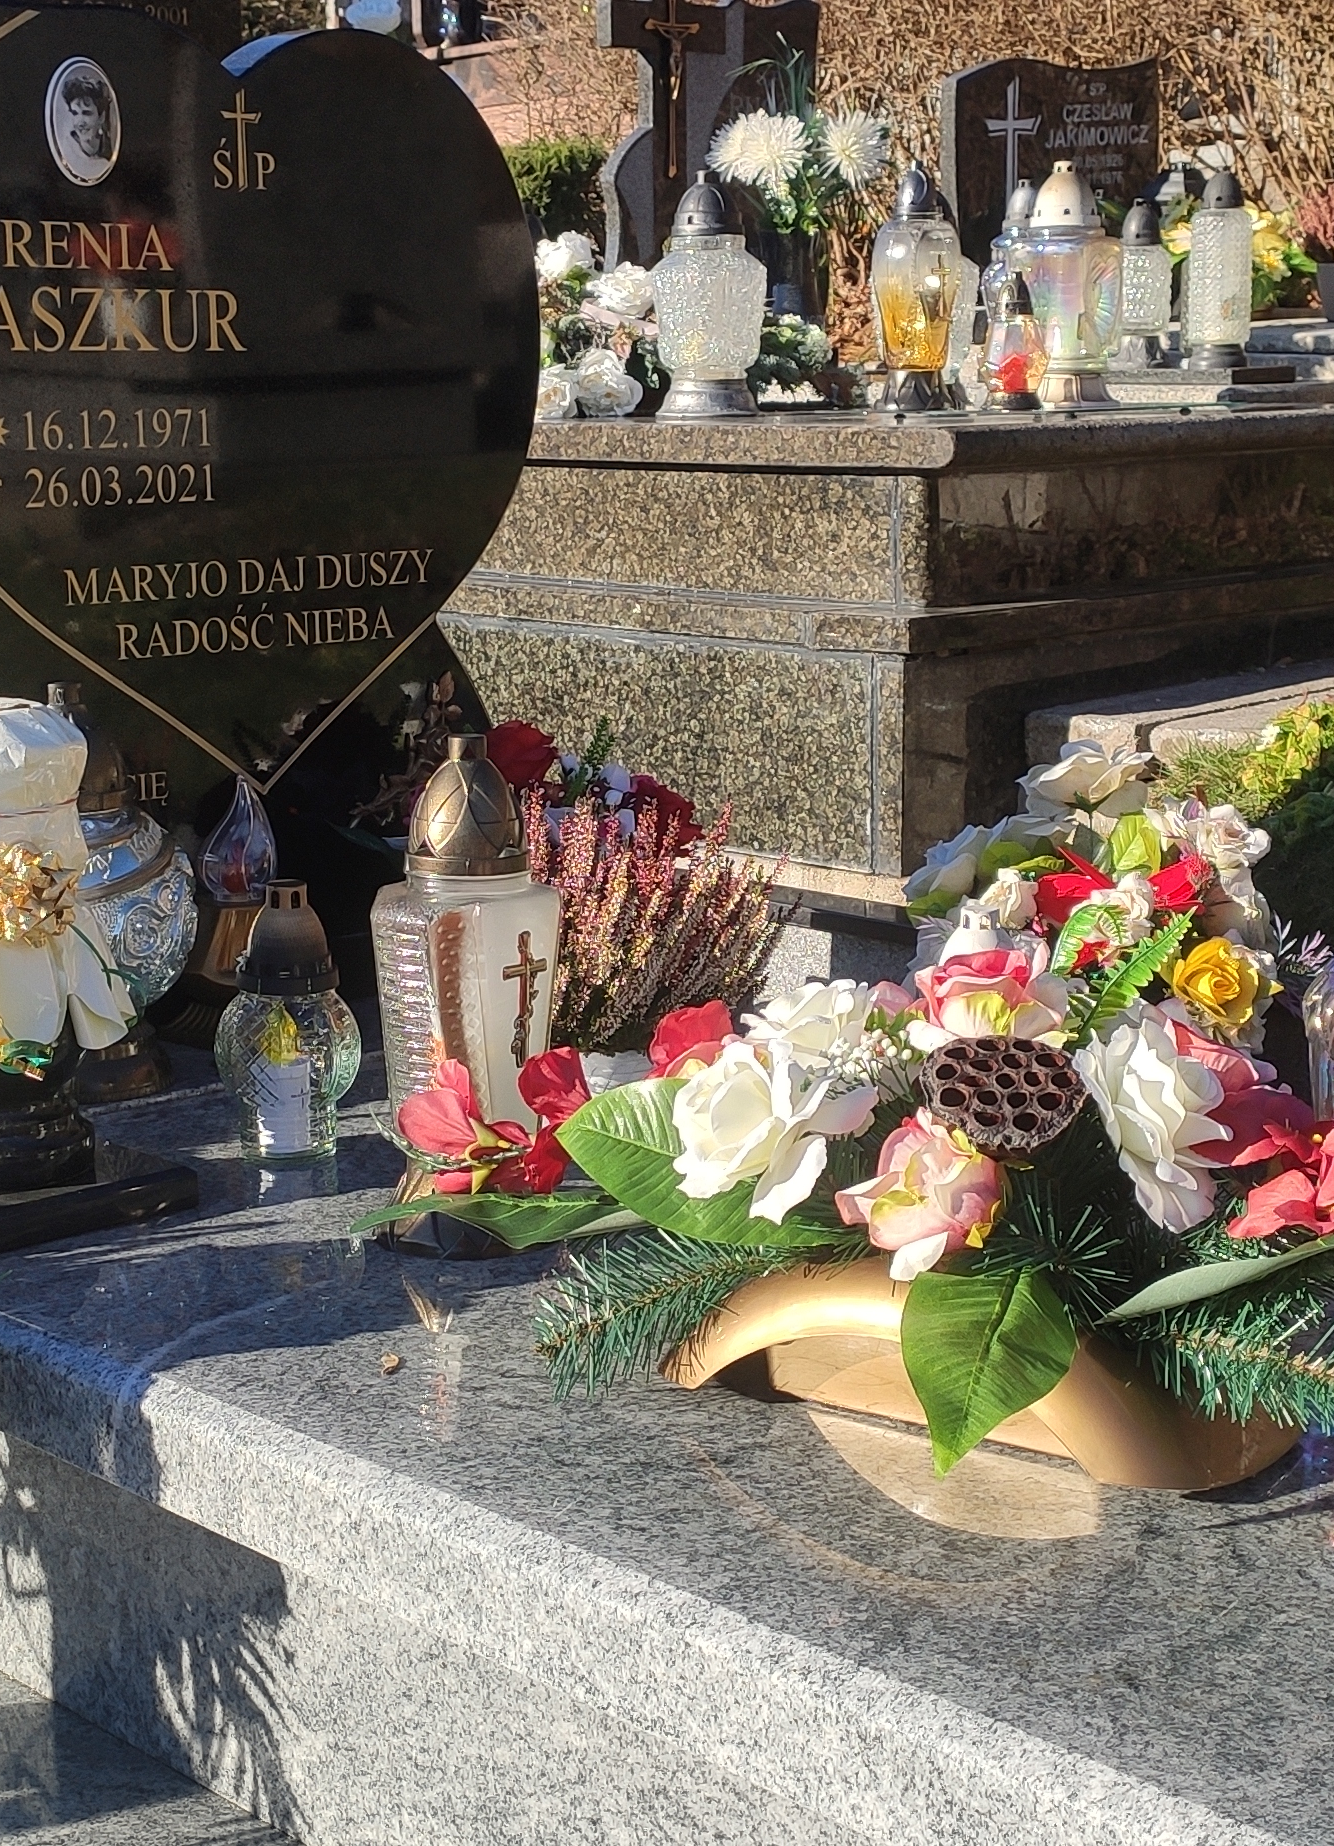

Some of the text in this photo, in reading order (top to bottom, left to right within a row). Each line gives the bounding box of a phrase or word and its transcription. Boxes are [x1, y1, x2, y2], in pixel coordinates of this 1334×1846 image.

[0, 219, 174, 271] RENIA
[22, 408, 211, 451] 16.12.1971
[24, 464, 216, 508] 26.03.2021
[63, 548, 434, 607] MARYJO DAJ DUSZY
[116, 603, 395, 661] RADOŚĆ NIEBA
[127, 771, 169, 806] IĘ
